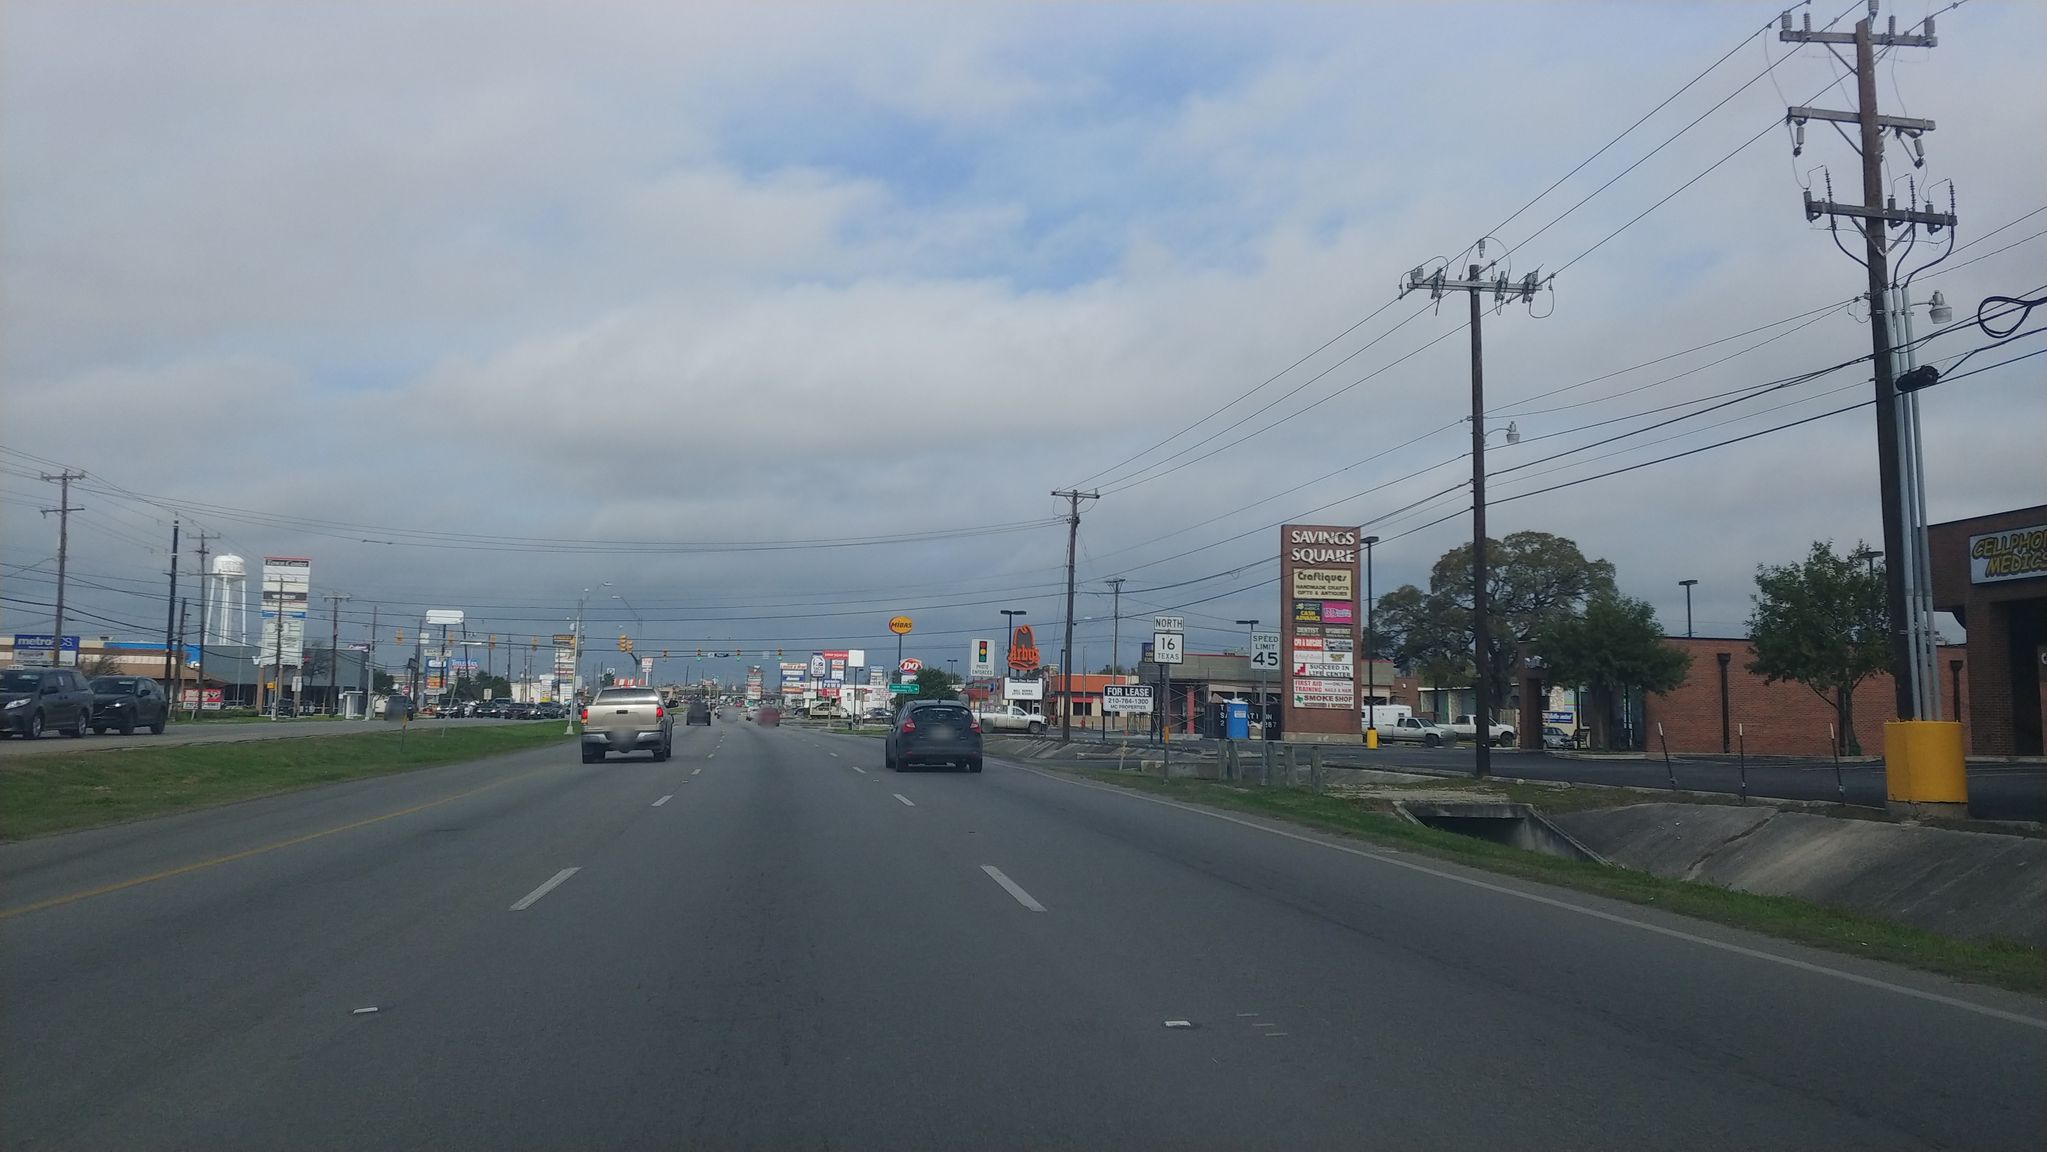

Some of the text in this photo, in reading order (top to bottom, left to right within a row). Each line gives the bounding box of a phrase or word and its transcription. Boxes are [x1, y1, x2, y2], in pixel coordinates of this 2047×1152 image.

[1292, 530, 1354, 545] SAVINGS
[1972, 529, 2047, 560] CELLPHO
[1292, 548, 1354, 563] SQUARE
[1298, 572, 1346, 583] Craftiques
[891, 621, 912, 629] MIDAS
[1155, 618, 1183, 628] NORTH
[1161, 637, 1176, 650] 16
[1252, 635, 1279, 643] SPEED
[1157, 652, 1179, 660] TEXAS
[1252, 651, 1278, 666] 45
[904, 662, 919, 670] DQ
[1107, 688, 1149, 696] FOR LEASE
